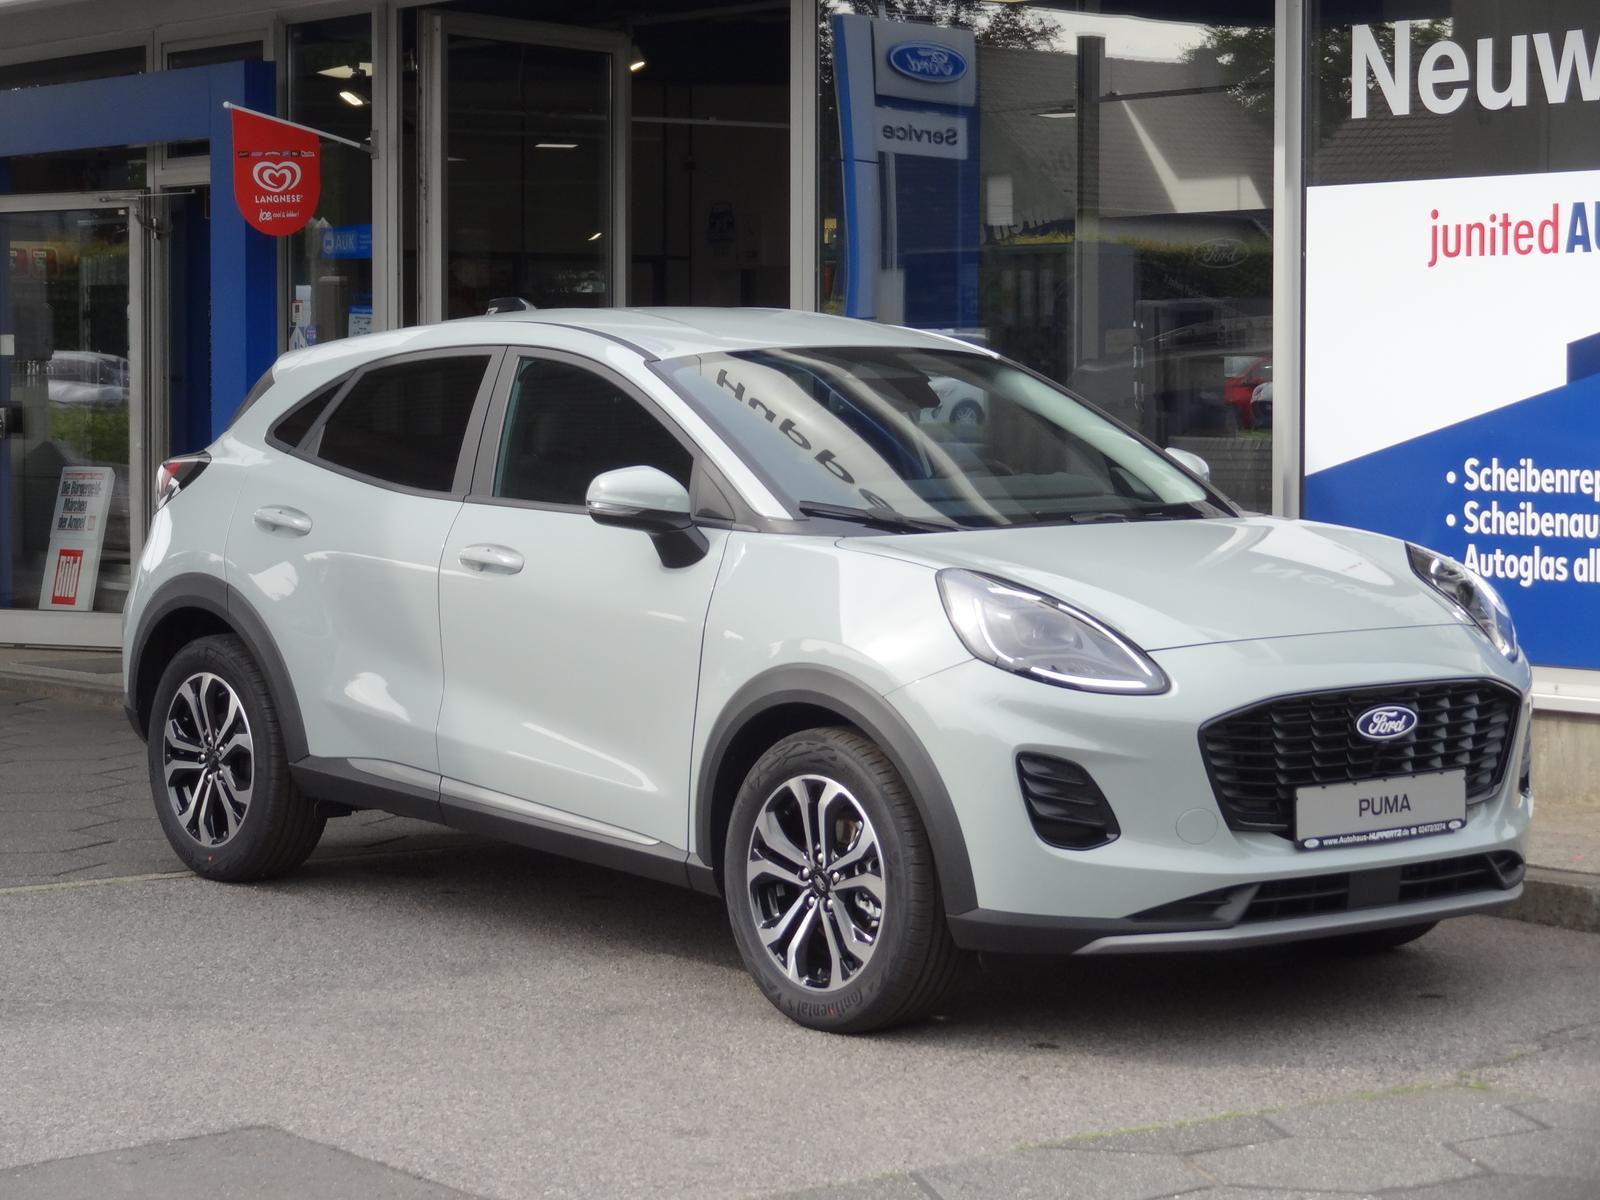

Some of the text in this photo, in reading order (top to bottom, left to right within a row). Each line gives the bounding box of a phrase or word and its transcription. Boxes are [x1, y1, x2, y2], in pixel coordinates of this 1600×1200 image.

[1351, 20, 1600, 119] Neuw
[255, 194, 301, 204] LANGNESE
[1463, 500, 1600, 539] Scheibenau
[54, 556, 80, 597] Bild
[1463, 543, 1568, 588] Autoglas
[1368, 711, 1407, 735] Ford
[1358, 793, 1411, 817] PUMA
